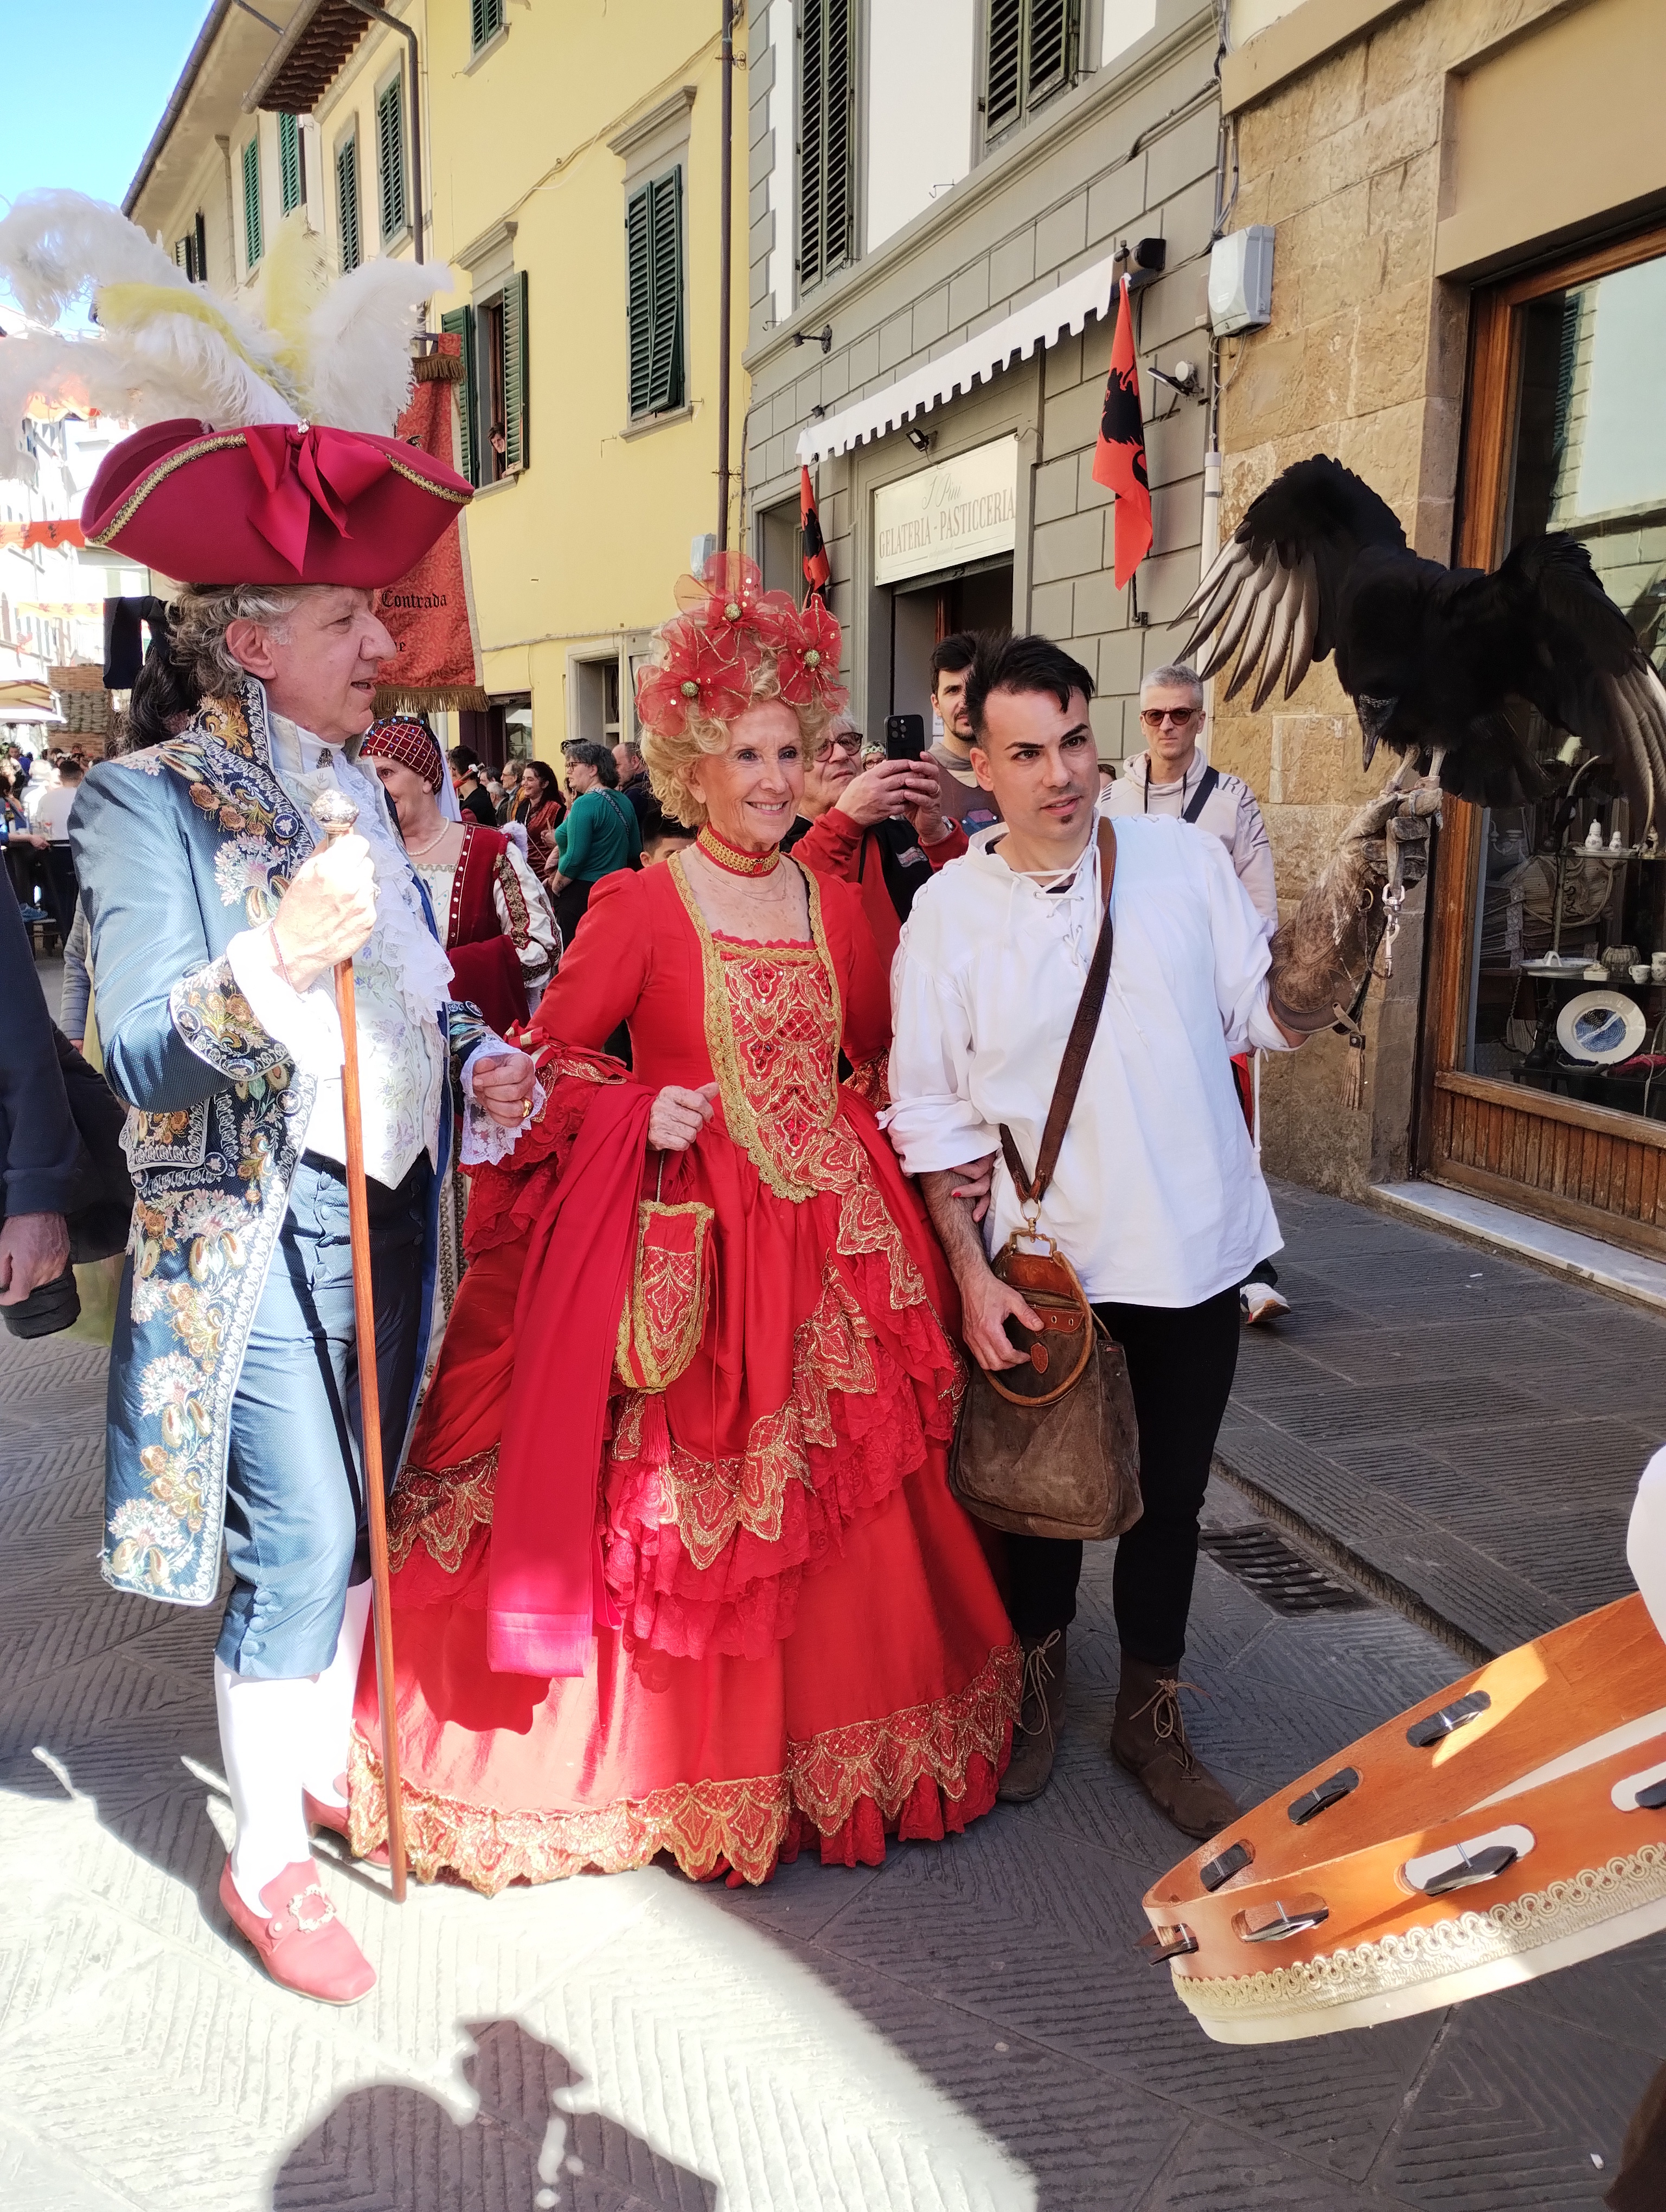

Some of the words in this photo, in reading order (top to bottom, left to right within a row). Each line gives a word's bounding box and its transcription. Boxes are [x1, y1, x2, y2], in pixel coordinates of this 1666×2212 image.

[879, 516, 931, 559] GELATERIA
[940, 487, 1015, 541] PASTICCERIA
[381, 590, 447, 609] Contrada
